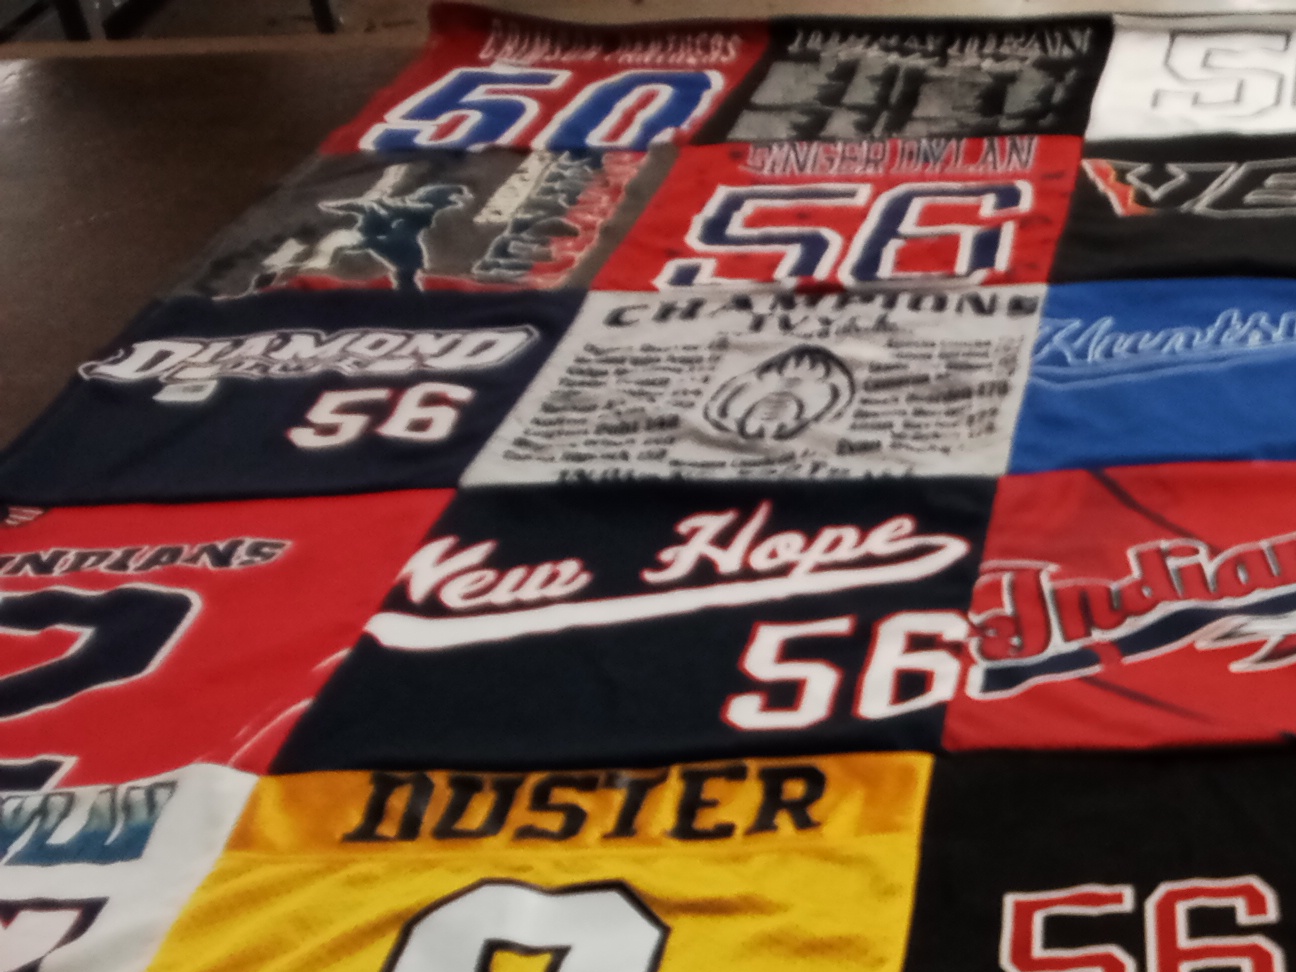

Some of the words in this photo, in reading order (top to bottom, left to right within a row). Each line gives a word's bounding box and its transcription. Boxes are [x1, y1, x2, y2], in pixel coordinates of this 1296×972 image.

[654, 180, 1035, 290] 56
[79, 323, 539, 382] DIAMOND
[285, 381, 478, 451] 56
[395, 534, 593, 610] New
[641, 499, 918, 584] Hope
[722, 609, 974, 732] 56
[341, 760, 829, 844] DUSTER
